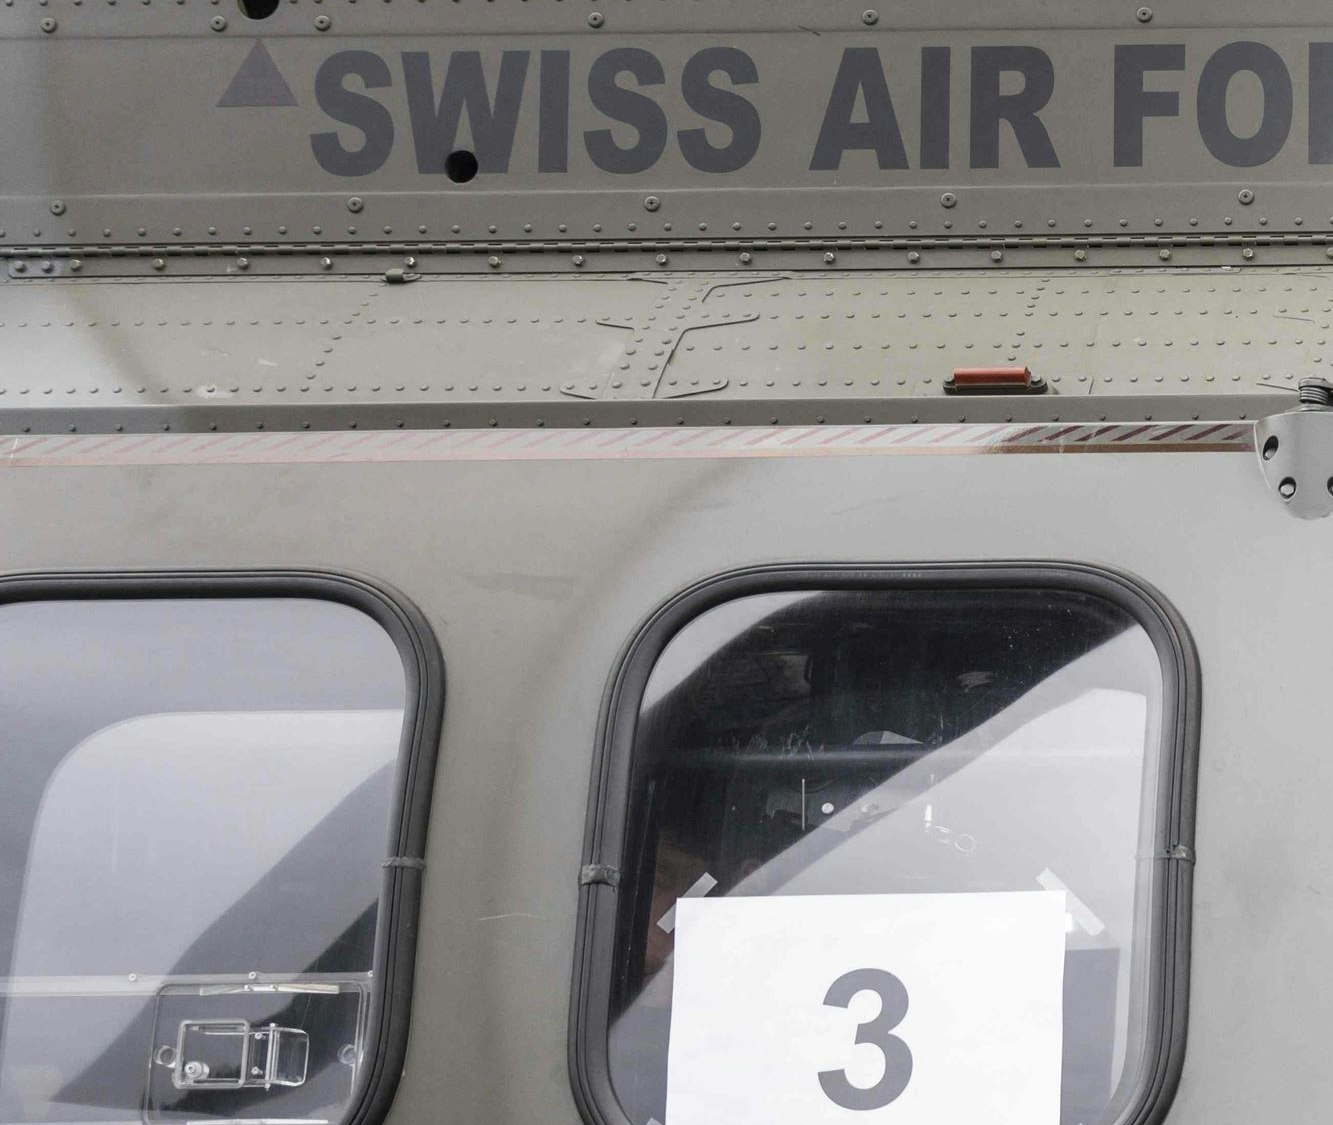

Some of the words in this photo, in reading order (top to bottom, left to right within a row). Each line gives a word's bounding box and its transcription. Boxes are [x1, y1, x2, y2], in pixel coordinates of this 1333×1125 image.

[311, 47, 762, 177] SWISS
[809, 45, 1061, 171] AIR
[817, 967, 913, 1111] 3
